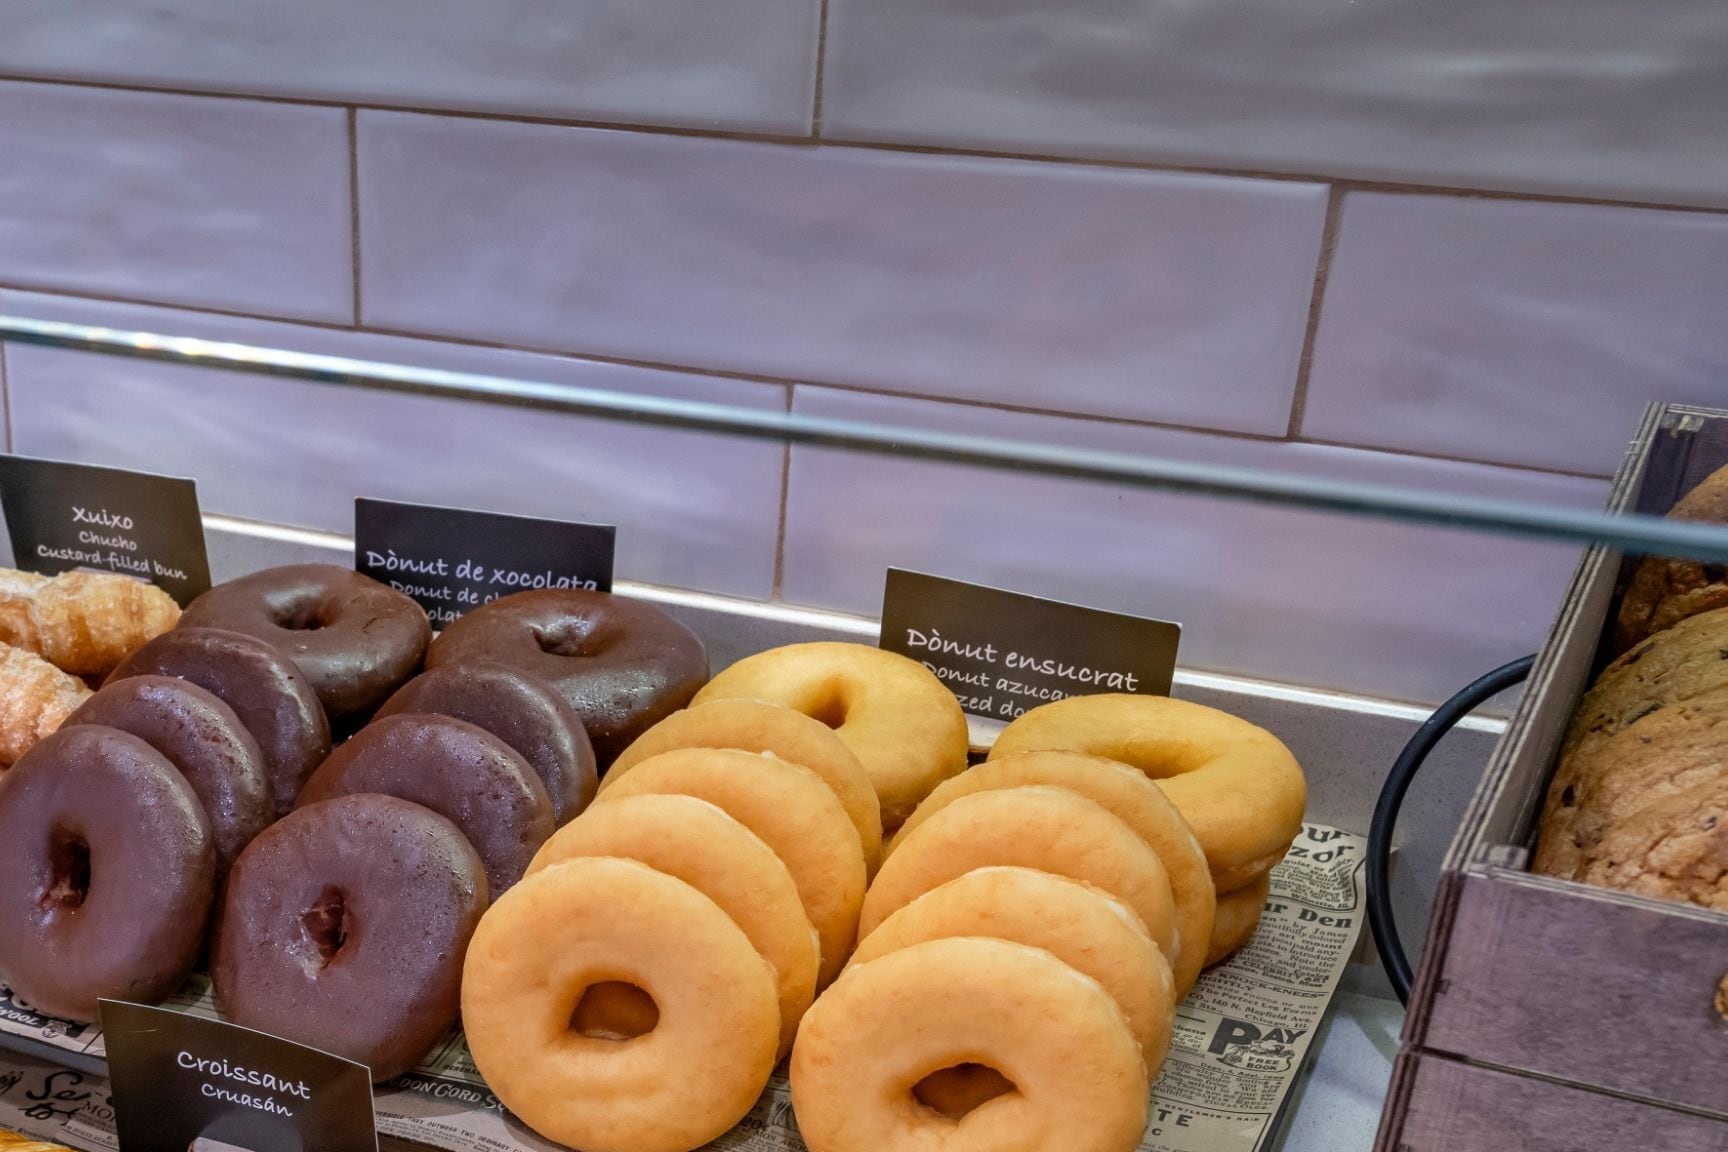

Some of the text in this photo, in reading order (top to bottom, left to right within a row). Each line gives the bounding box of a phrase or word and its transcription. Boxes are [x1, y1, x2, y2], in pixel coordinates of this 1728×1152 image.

[72, 506, 134, 530] Xuixo
[154, 560, 188, 581] bun
[366, 549, 449, 577] Dònut
[456, 560, 485, 582] de
[457, 587, 479, 605] de
[906, 628, 1140, 693] Dònut ensucrat
[1298, 907, 1353, 929] Den
[1207, 1017, 1309, 1056] PAY
[1246, 1062, 1279, 1071] BOOK
[1247, 1056, 1281, 1065] FREE
[177, 1051, 311, 1100] Croissant
[427, 1121, 458, 1133] OUTWEAR
[478, 1135, 511, 1151] ORDINARY
